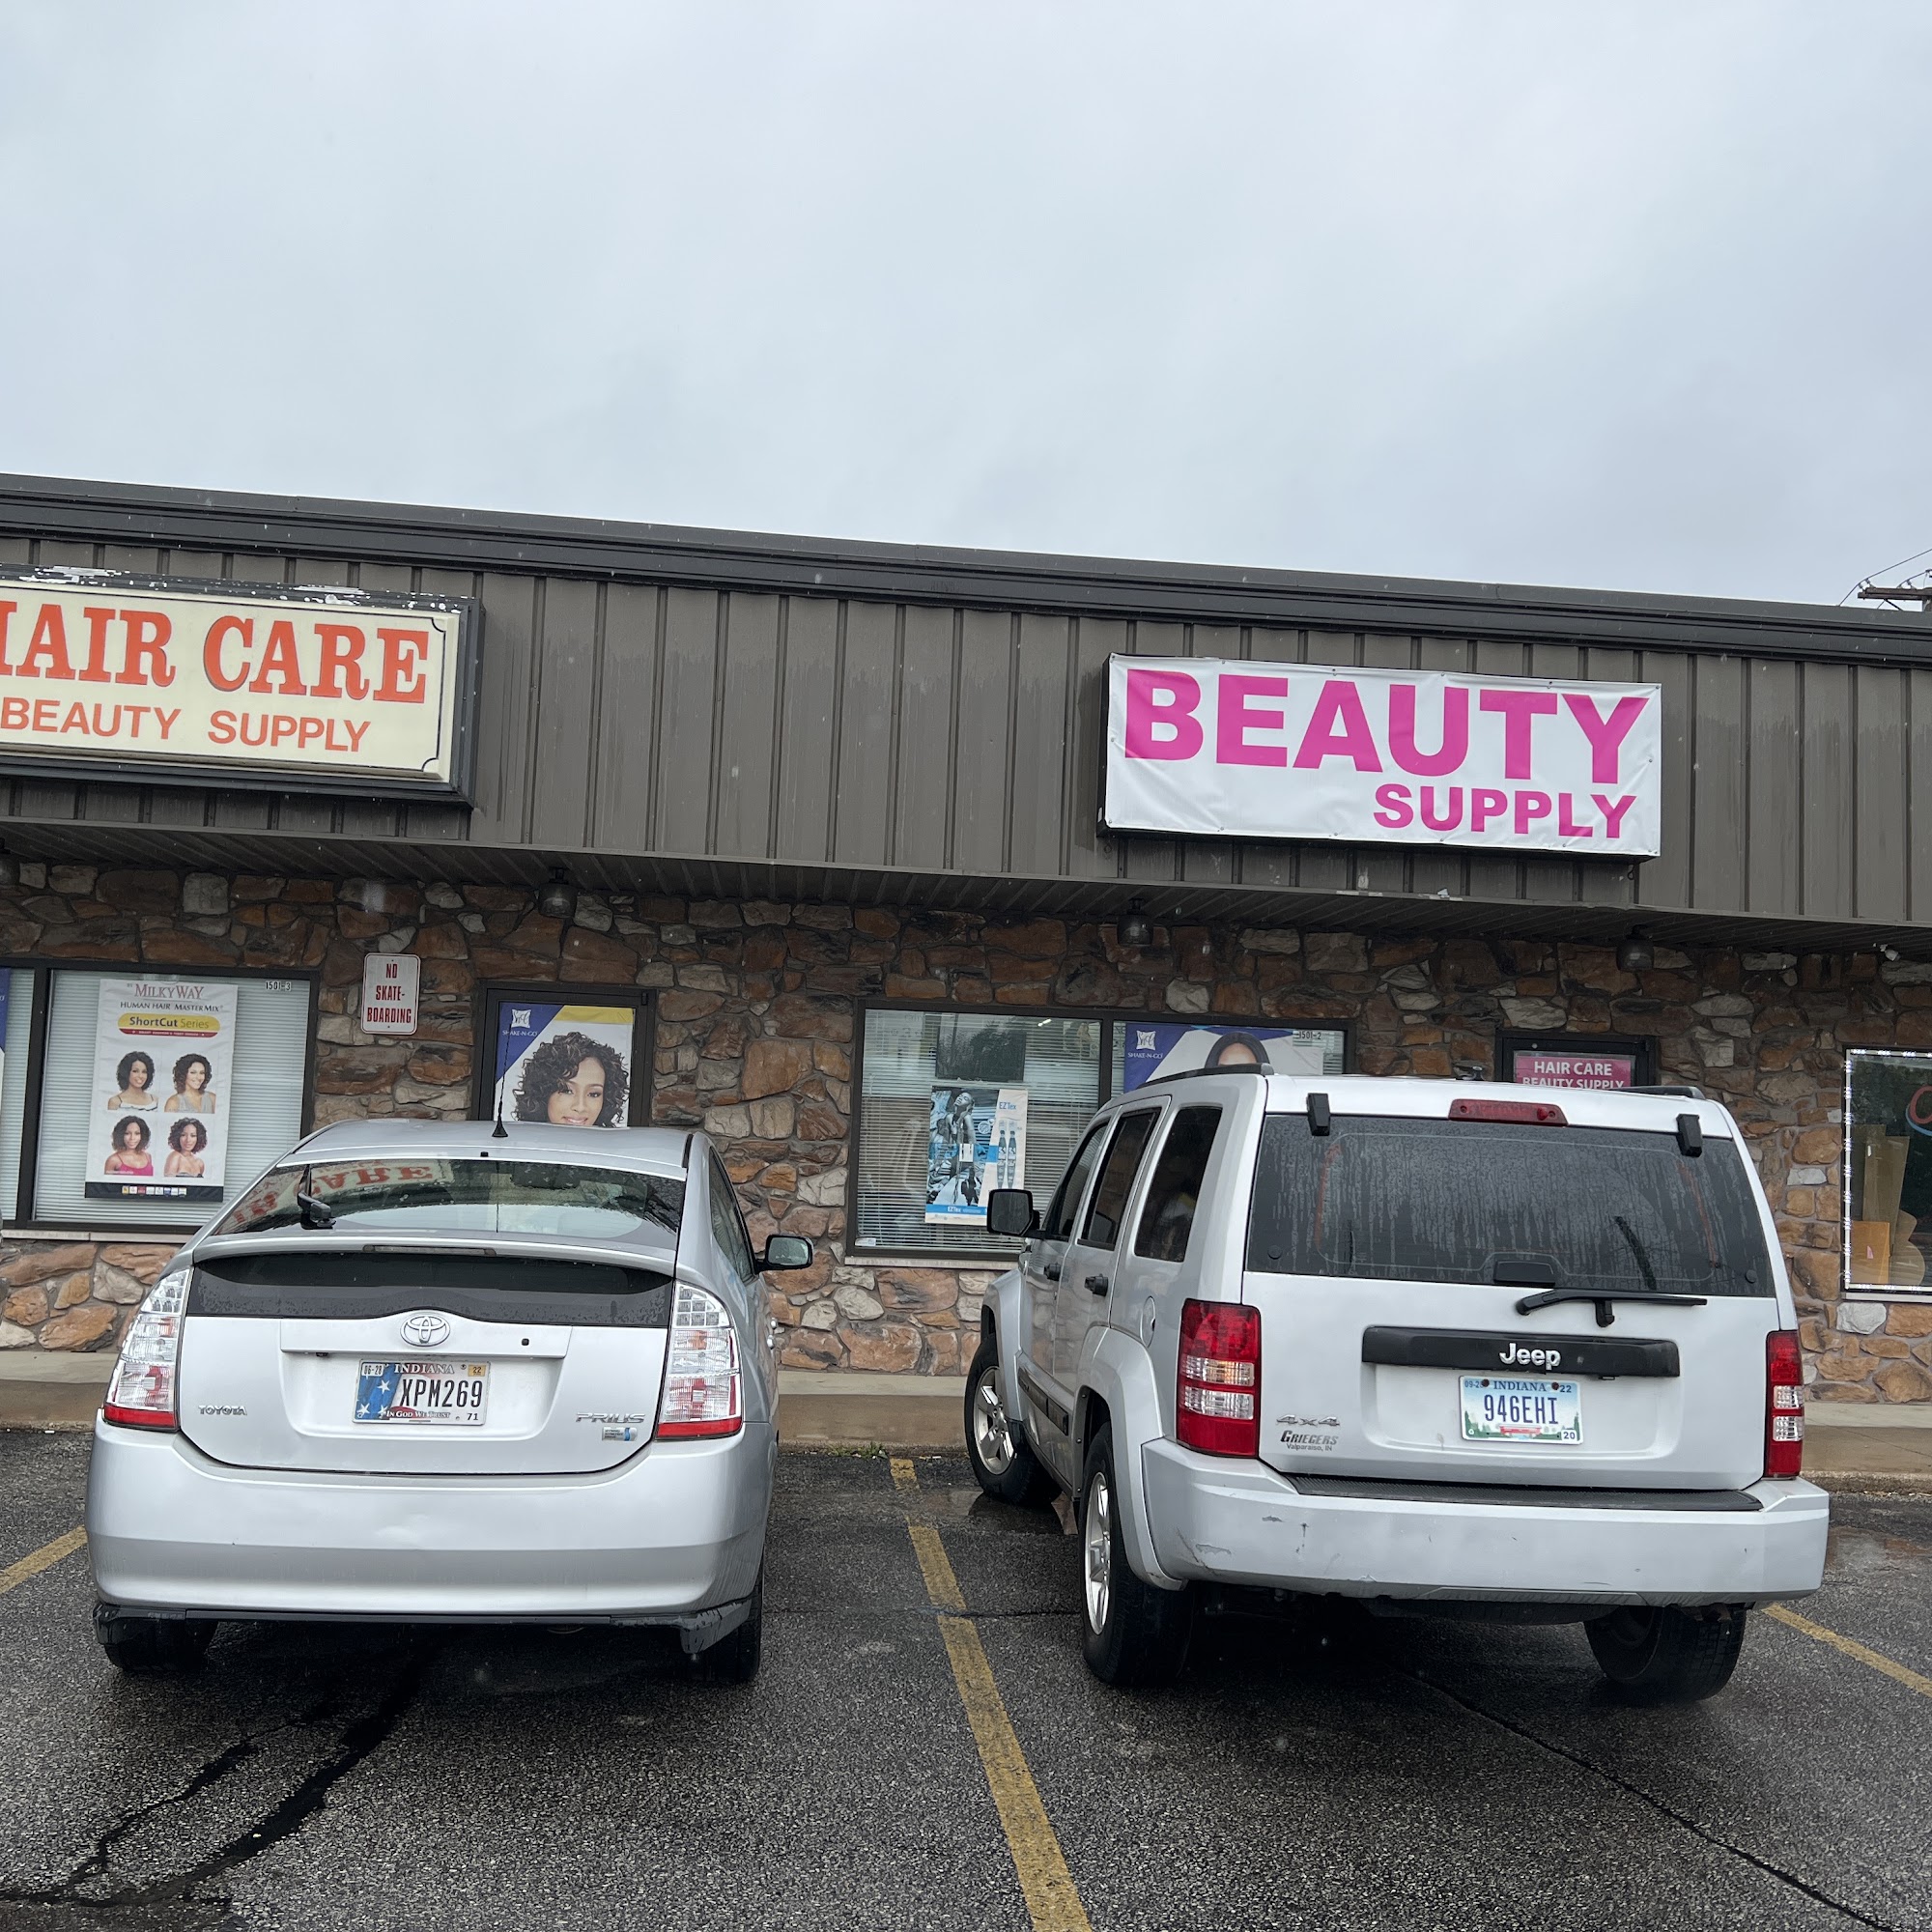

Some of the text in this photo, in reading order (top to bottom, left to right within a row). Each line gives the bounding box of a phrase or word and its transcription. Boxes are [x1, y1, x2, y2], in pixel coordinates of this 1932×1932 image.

[0, 601, 429, 703] AIR CARE
[1, 696, 372, 753] BEAUTY SUPPLY
[1124, 668, 1650, 784] BEAUTY
[1373, 783, 1637, 838] SUPPLY
[385, 963, 398, 979] NO
[266, 980, 291, 991] 1501-3
[376, 985, 406, 1001] SKATE-
[120, 1001, 151, 1009] HUMAN
[152, 1002, 171, 1010] HAIR
[129, 1016, 210, 1030] ShortCut Series
[367, 1007, 412, 1024] BOARDING
[1534, 1061, 1612, 1076] HAIR CARE
[1499, 1342, 1562, 1371] Jeep
[393, 1363, 455, 1375] INDIANA
[399, 1378, 483, 1407] XPM269
[1493, 1380, 1548, 1392] INDIANA
[1559, 1384, 1573, 1393] 22
[198, 1405, 248, 1416] TOYOTA
[467, 1412, 479, 1421] 71
[1484, 1394, 1559, 1425] 946EHI
[575, 1412, 646, 1424] PRIUS
[1563, 1431, 1576, 1440] 20
